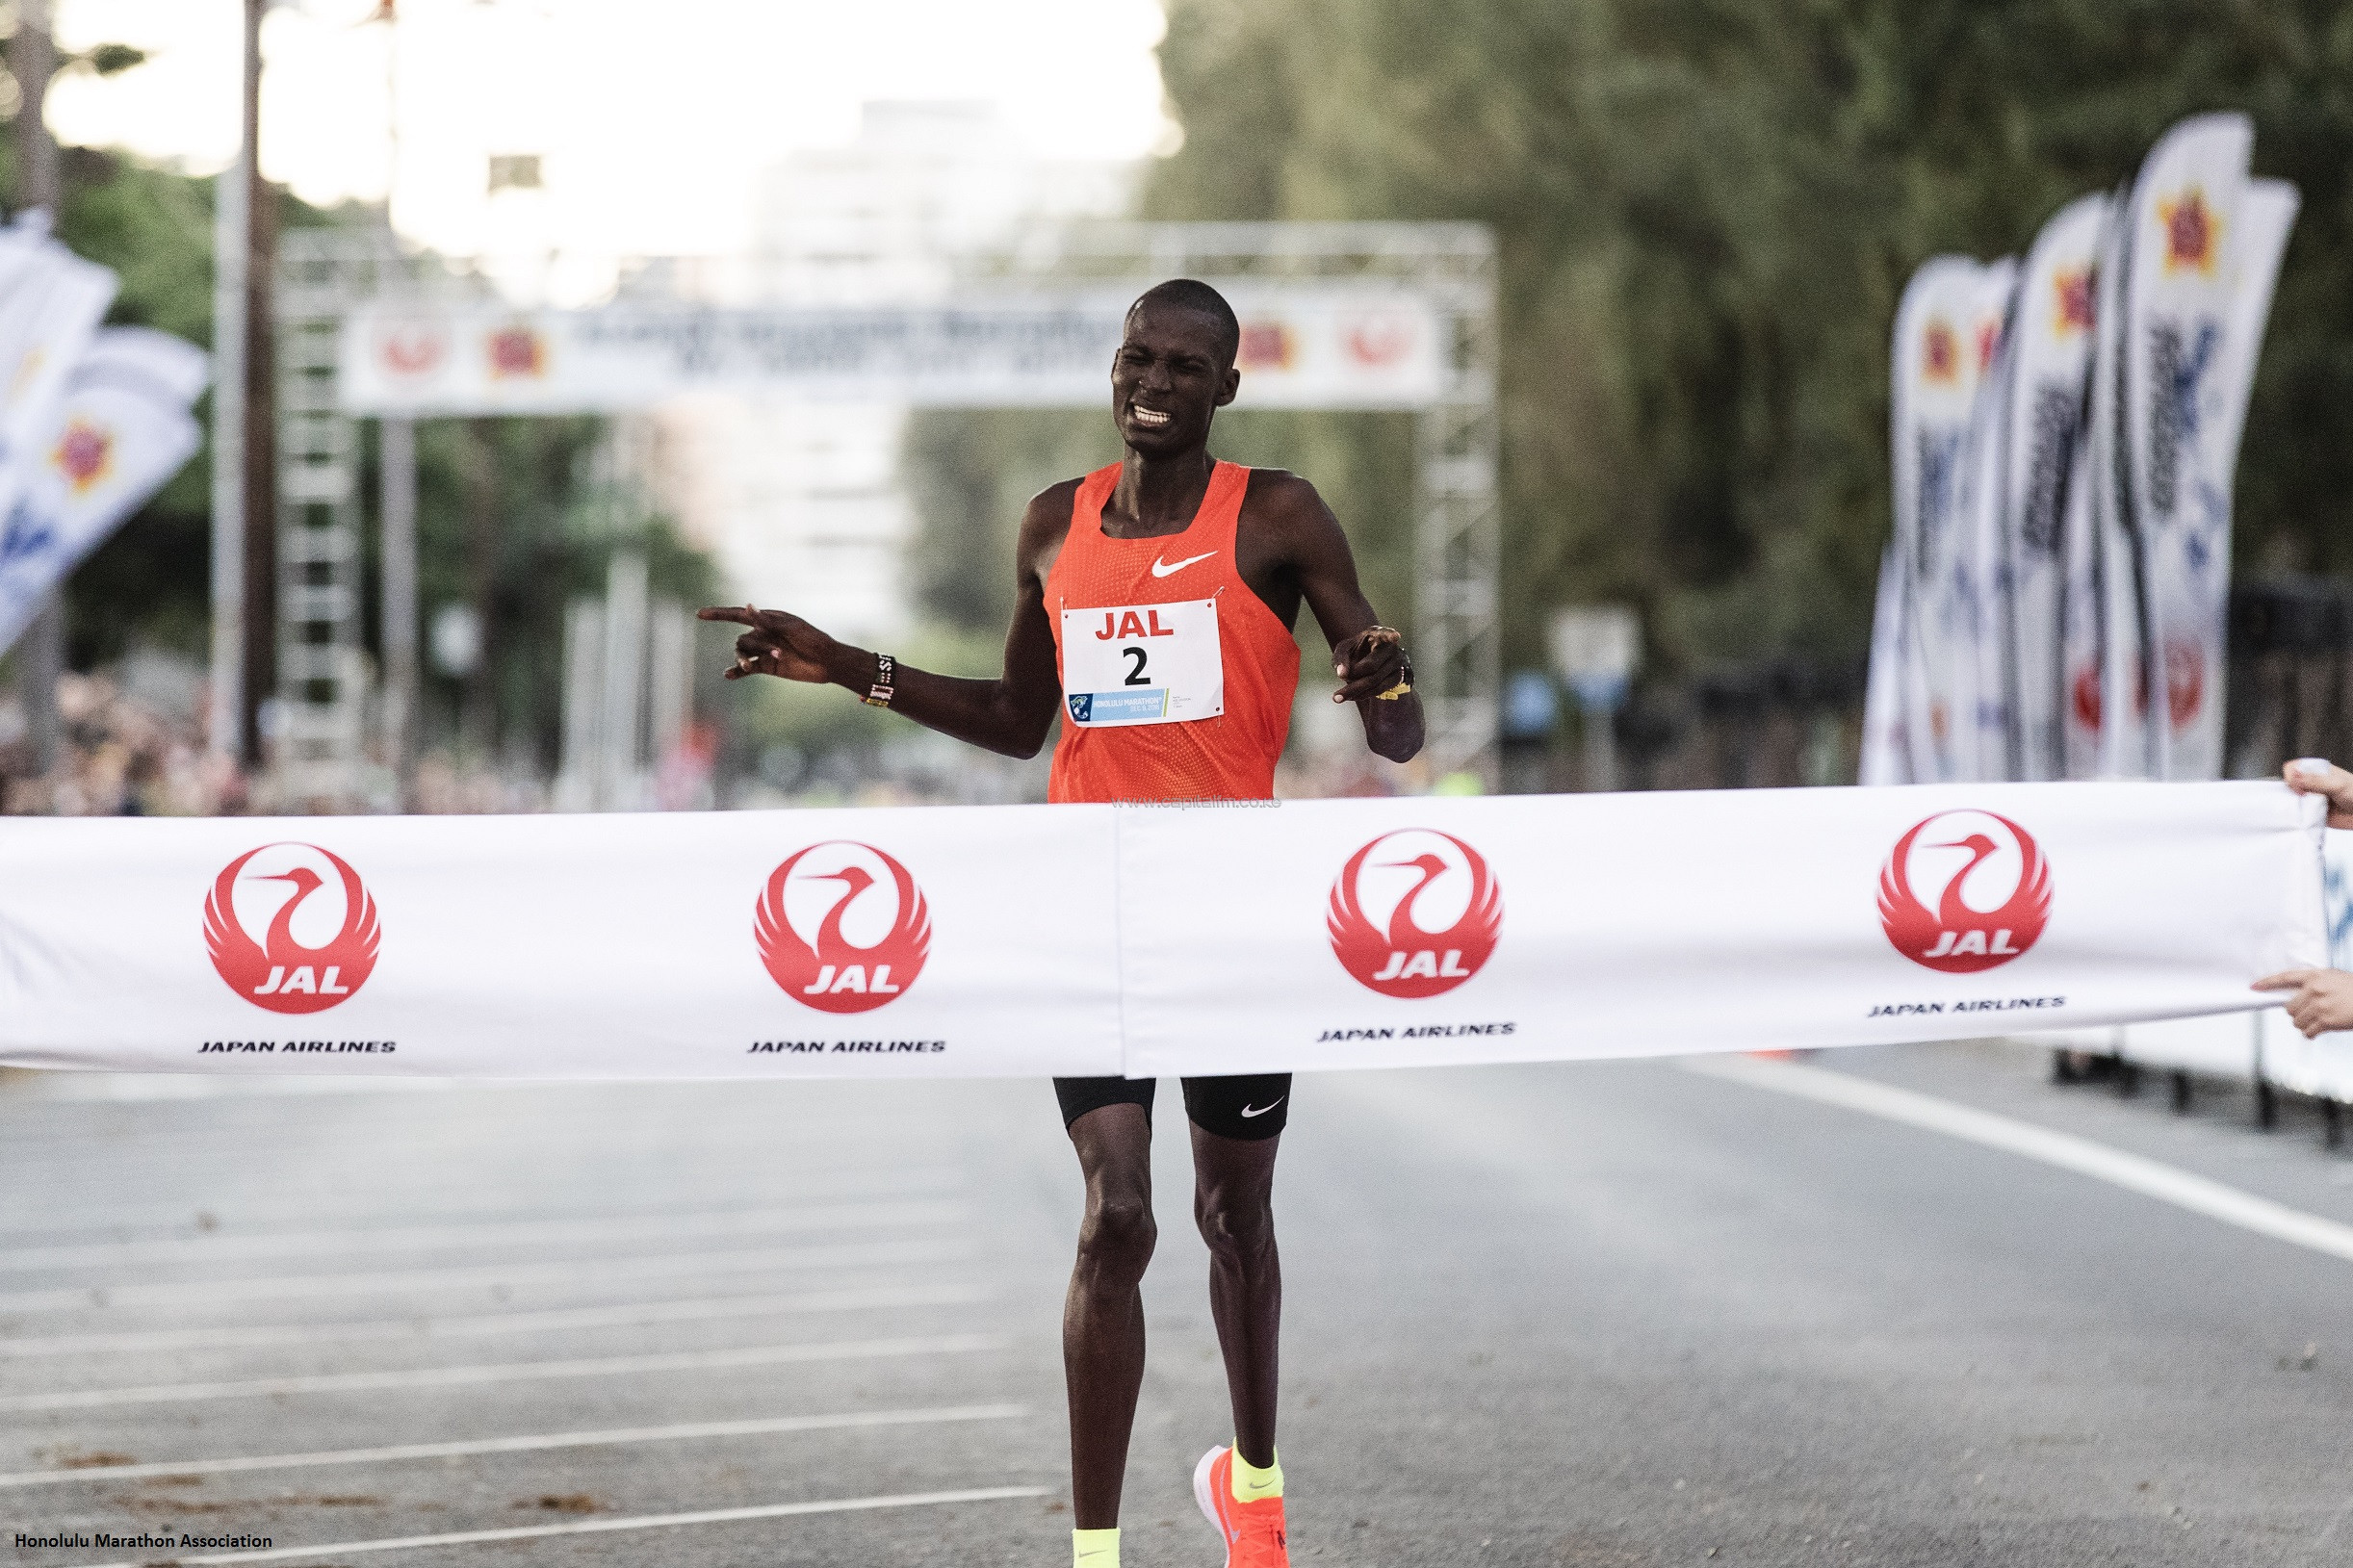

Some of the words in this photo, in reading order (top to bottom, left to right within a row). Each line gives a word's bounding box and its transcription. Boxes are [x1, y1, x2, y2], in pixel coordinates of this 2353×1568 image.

[1096, 609, 1174, 640] JAL
[1123, 647, 1151, 685] 2
[1094, 700, 1123, 708] HONOLULU
[1923, 929, 2019, 958] JAL
[254, 965, 349, 994] JAL
[804, 964, 899, 994] JAL
[1373, 949, 1470, 981] JAL
[1867, 1002, 1945, 1017] JAPAN
[1952, 995, 2066, 1013] AIRLINES
[1317, 1027, 1394, 1042] JAPAN
[1401, 1021, 1517, 1039] AIRLINES
[197, 1041, 276, 1053] JAPAN
[281, 1041, 397, 1053] AIRLINES
[747, 1041, 825, 1053] JAPAN
[831, 1041, 946, 1053] AIRLINES
